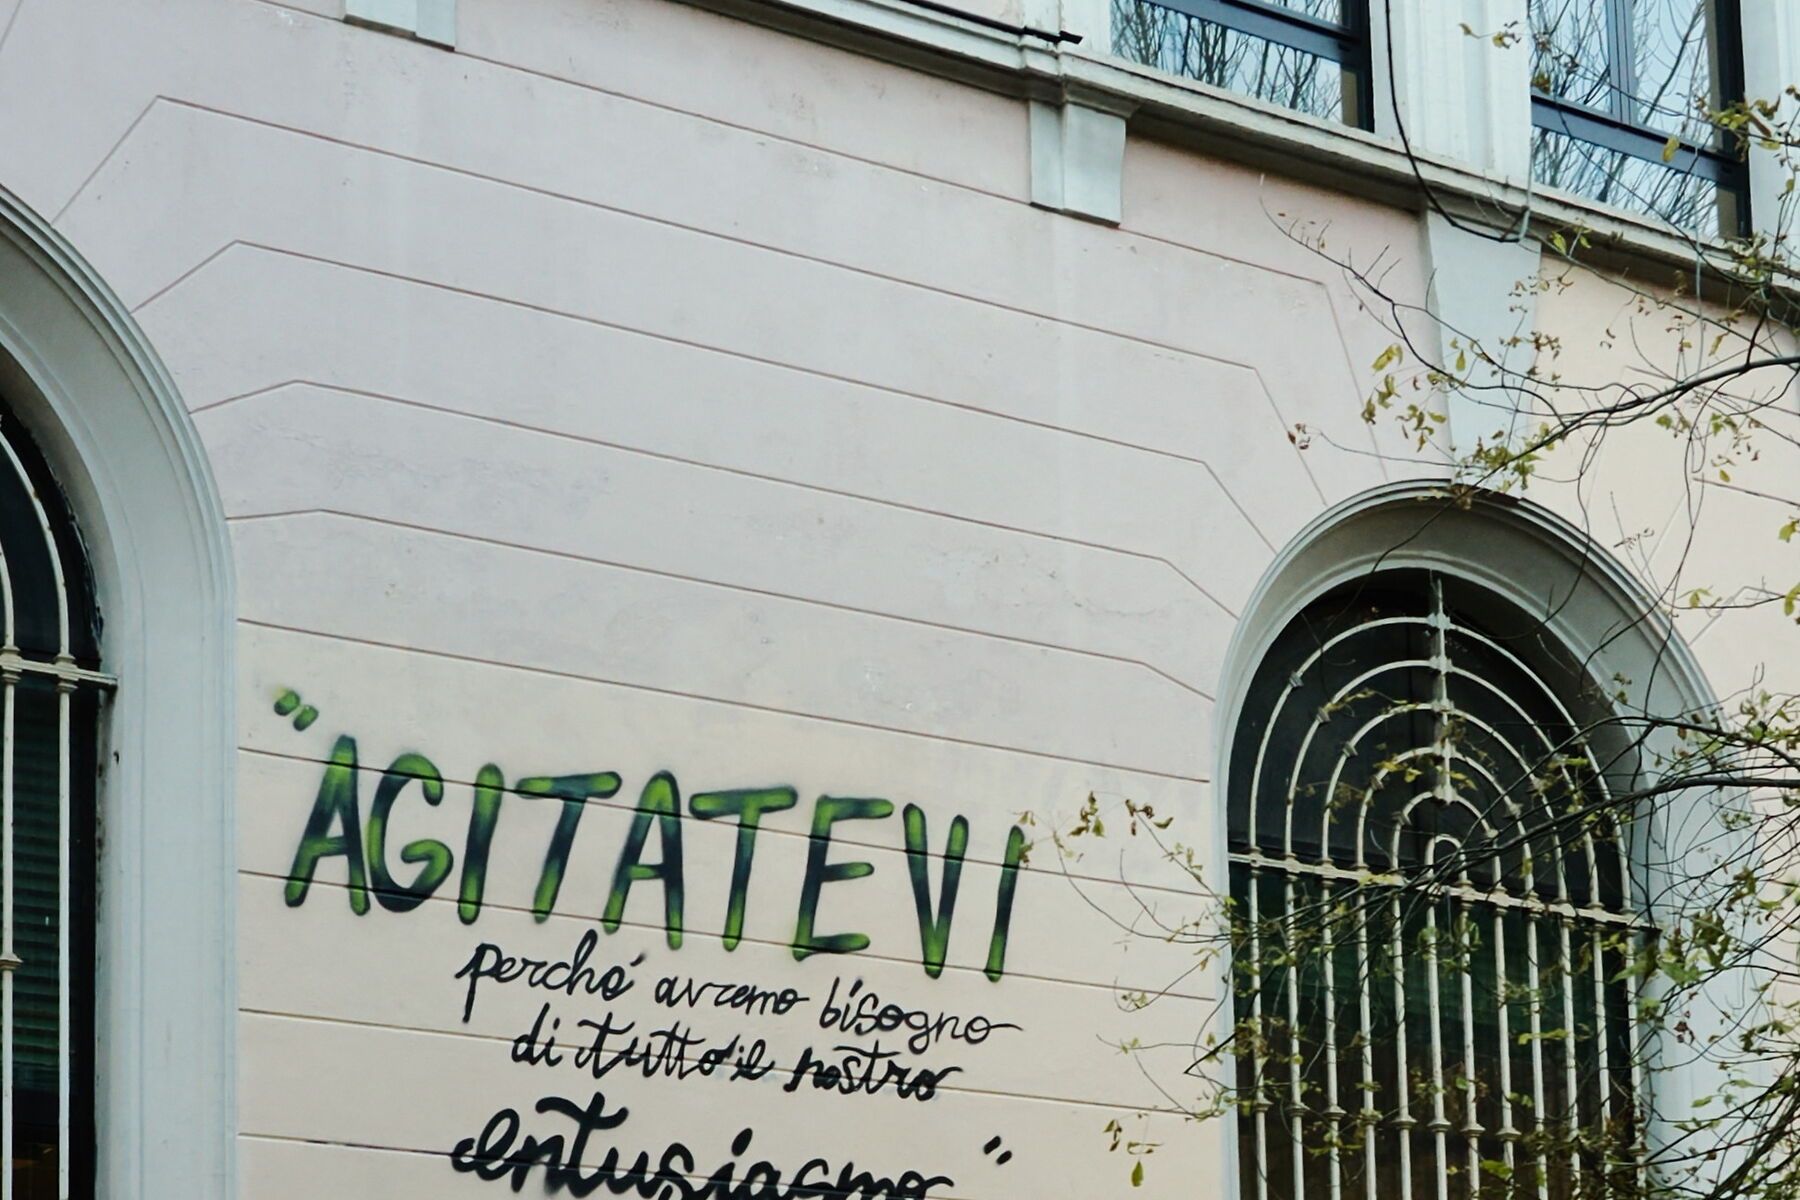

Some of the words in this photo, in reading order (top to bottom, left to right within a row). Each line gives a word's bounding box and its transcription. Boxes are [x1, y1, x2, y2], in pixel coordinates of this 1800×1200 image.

[511, 1003, 563, 1067] di
[574, 1011, 741, 1080] tutto
[729, 1038, 775, 1081] il
[783, 1039, 964, 1102] nostro
[654, 976, 810, 1015] avremo
[819, 976, 1023, 1055] bisogno
